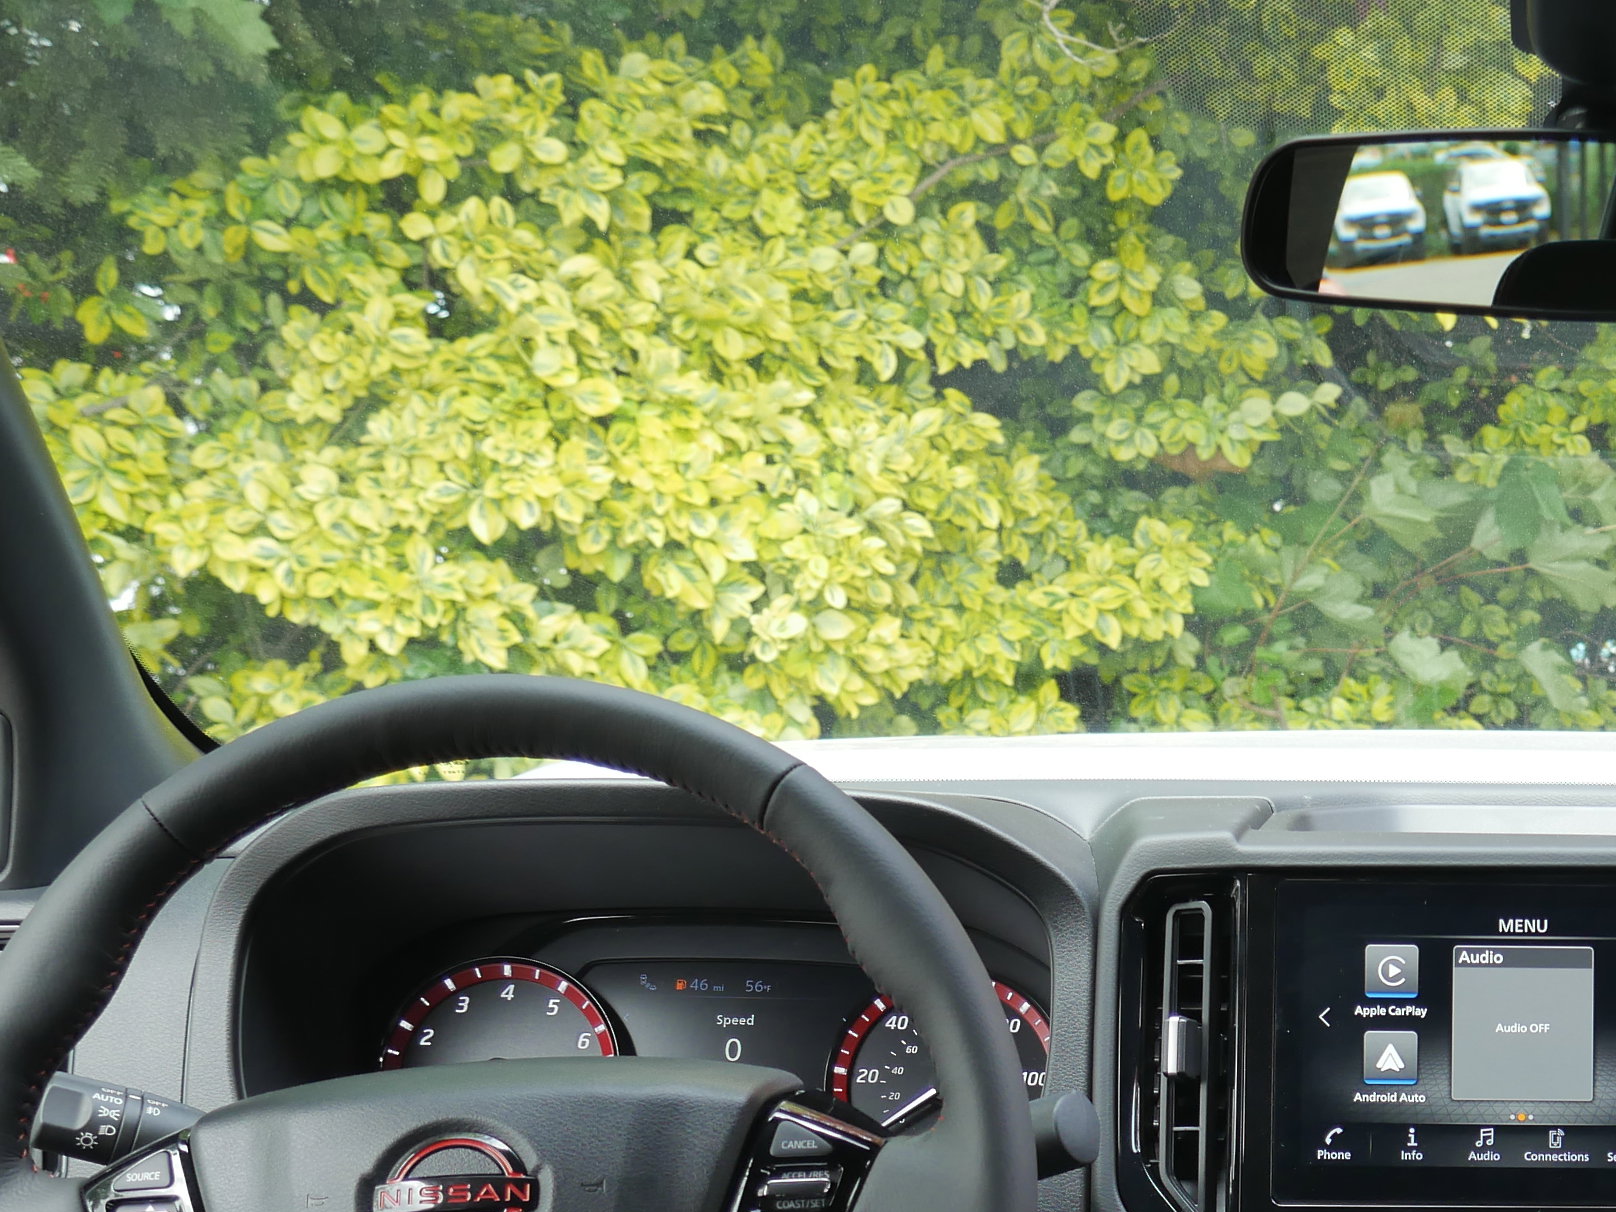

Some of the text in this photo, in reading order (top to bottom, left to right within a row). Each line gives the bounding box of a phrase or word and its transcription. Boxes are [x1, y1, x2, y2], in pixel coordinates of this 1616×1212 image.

[1499, 919, 1549, 933] MENU
[1459, 951, 1503, 965] Audio
[690, 979, 708, 991] 46
[500, 984, 515, 1001] 4
[455, 997, 470, 1013] 3
[546, 999, 560, 1016] 5
[1354, 1006, 1428, 1018] Apple CarPlay
[716, 1014, 754, 1027] Speed
[884, 1015, 909, 1031] 40
[1495, 1023, 1550, 1033] Audio OFF
[420, 1029, 435, 1046] 2
[578, 1033, 591, 1049] 6
[725, 1038, 742, 1062] 0
[905, 1044, 918, 1054] 60
[856, 1069, 879, 1084] 20
[891, 1066, 904, 1076] 40
[92, 1093, 123, 1105] AUTO
[888, 1091, 900, 1100] 20
[1354, 1092, 1426, 1103] Android Auto
[781, 1140, 818, 1150] CANCEL
[1317, 1149, 1351, 1160] Phone
[1401, 1150, 1423, 1160] Info
[1468, 1151, 1500, 1162] Audio
[1524, 1151, 1589, 1162] Connections
[126, 1172, 160, 1182] SOURCE
[379, 1183, 531, 1209] NISSAN
[776, 1199, 825, 1209] COAST/SET
